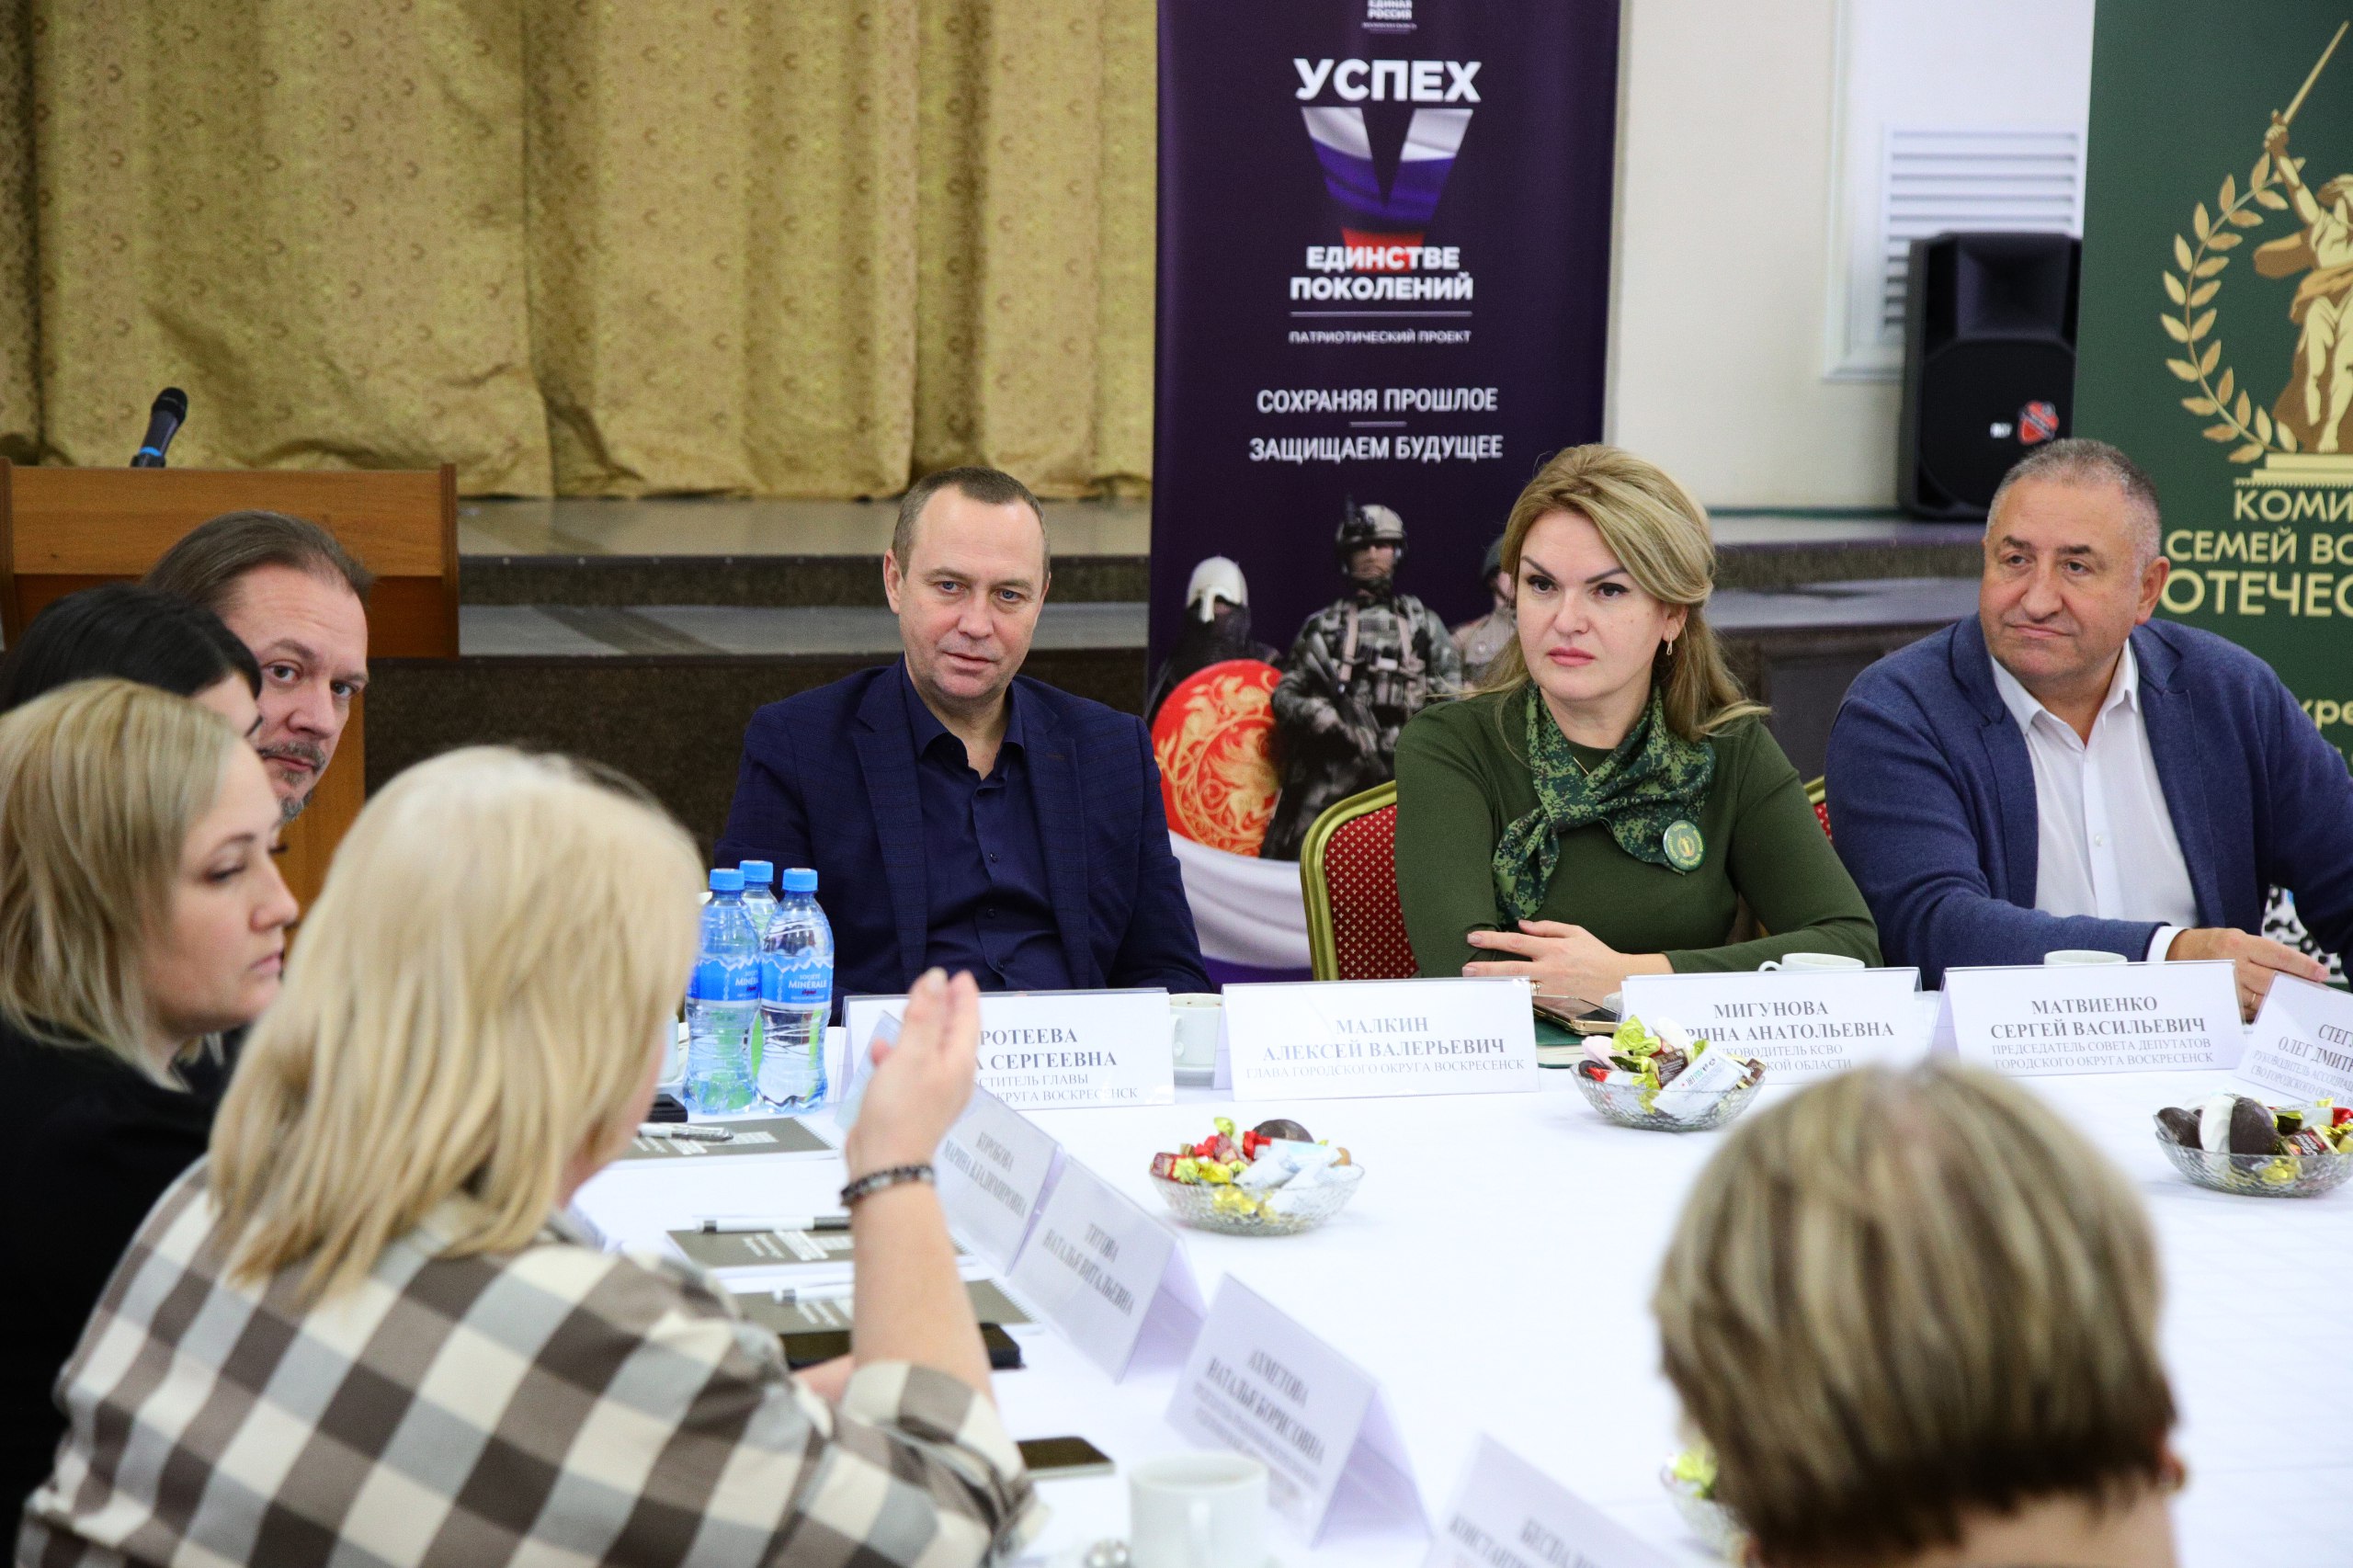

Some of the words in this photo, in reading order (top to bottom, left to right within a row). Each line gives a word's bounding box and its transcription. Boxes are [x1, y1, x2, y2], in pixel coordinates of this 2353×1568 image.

[1293, 58, 1482, 102] УСПЕХ
[1306, 245, 1461, 273] ЕДИНСТВЕ
[1290, 272, 1473, 301] ПОКОЛЕНИЙ
[1289, 328, 1415, 344] ПАТРИОТИЧЕСКИЙ
[1417, 330, 1472, 344] ПРОЕКТ
[1256, 389, 1378, 414] СОХРАНЯЯ
[1383, 387, 1498, 412] ПРОШЛОЕ
[1249, 436, 1390, 465] ЗАЩИЩАЕМ
[1394, 435, 1504, 463] БУДУЩЕЕ
[2234, 489, 2353, 523] КОМИ
[2165, 525, 2298, 564] СЕМЕЙ
[788, 980, 827, 989] MINÉRALE
[1713, 1000, 1829, 1019] МИГУНОВА
[2030, 995, 2158, 1015] МАТВИЕНКО
[1336, 1017, 1429, 1035] МАЛКИН
[1686, 1027, 1740, 1043] РИНА
[1745, 1021, 1895, 1041] АНАТОЛЬЕВНА
[1990, 1018, 2068, 1040] СЕРГЕЙ
[2072, 1017, 2207, 1037] ВАСИЛЬЕВИЧ
[979, 1027, 1078, 1046] РОТЕЕВА
[1263, 1040, 1363, 1061] АЛЕКСЕЙ
[1369, 1038, 1506, 1058] ВАЛЕРЬЕВИЧ
[1722, 1044, 1807, 1058] КОВОДИТЕЛЬ
[1811, 1044, 1844, 1055] КСВО
[1992, 1040, 2086, 1056] ПРЕДСЕДАТЕЛЬ
[2087, 1040, 2136, 1052] СОВЕТА
[2138, 1038, 2211, 1051] ДЕПУТАТОВ
[2279, 1036, 2313, 1058] ОЛЕГ
[990, 1051, 1118, 1071] СЕРГЕЕВНА
[1246, 1067, 1290, 1079] ГЛАВА
[1292, 1063, 1378, 1077] ГОРОДСКОГО
[1381, 1062, 1431, 1074] ОКРУГА
[1434, 1059, 1526, 1073] ВОСКРЕСЕНСК
[1794, 1058, 1853, 1071] ОБЛАСТИ
[1994, 1056, 2075, 1070] ГОРОДСКОГО
[2077, 1054, 2125, 1067] ОКРУГА
[2128, 1051, 2214, 1065] ВОСКРЕСЕНСК
[979, 1075, 1040, 1088] СТИТЕЛЬ
[1042, 1074, 1089, 1085] ГЛАВЫ
[995, 1091, 1040, 1103] КРУГА
